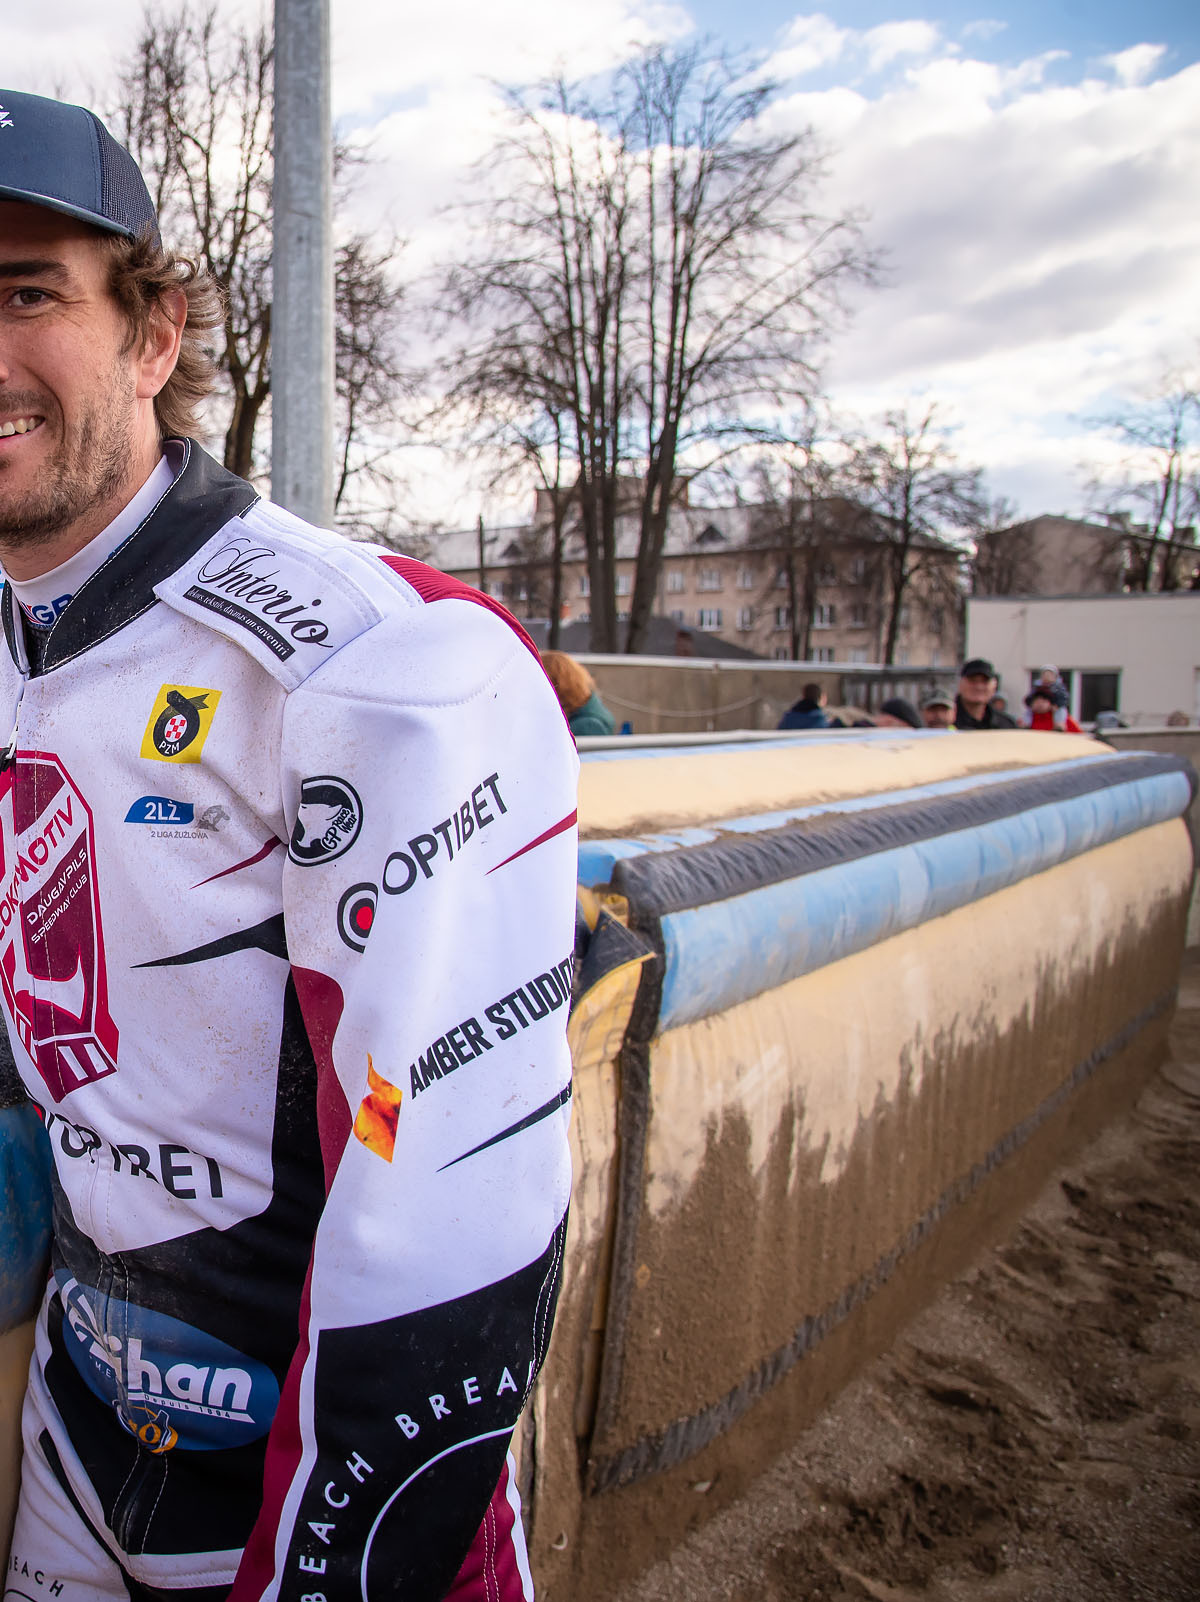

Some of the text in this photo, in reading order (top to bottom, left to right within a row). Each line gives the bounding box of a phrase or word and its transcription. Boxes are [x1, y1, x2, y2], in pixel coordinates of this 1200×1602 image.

[197, 537, 334, 648] Interio
[158, 740, 181, 755] PZM
[150, 830, 157, 839] 2
[156, 830, 174, 839] LIGA
[321, 826, 343, 850] GP
[331, 808, 351, 826] Race
[341, 813, 358, 834] Wear
[381, 772, 508, 896] OPTIBET
[26, 848, 88, 926] DAUGAVPILS
[30, 873, 89, 944] SPEEDWAY CLUB
[410, 950, 575, 1100] AMBER STUDIO
